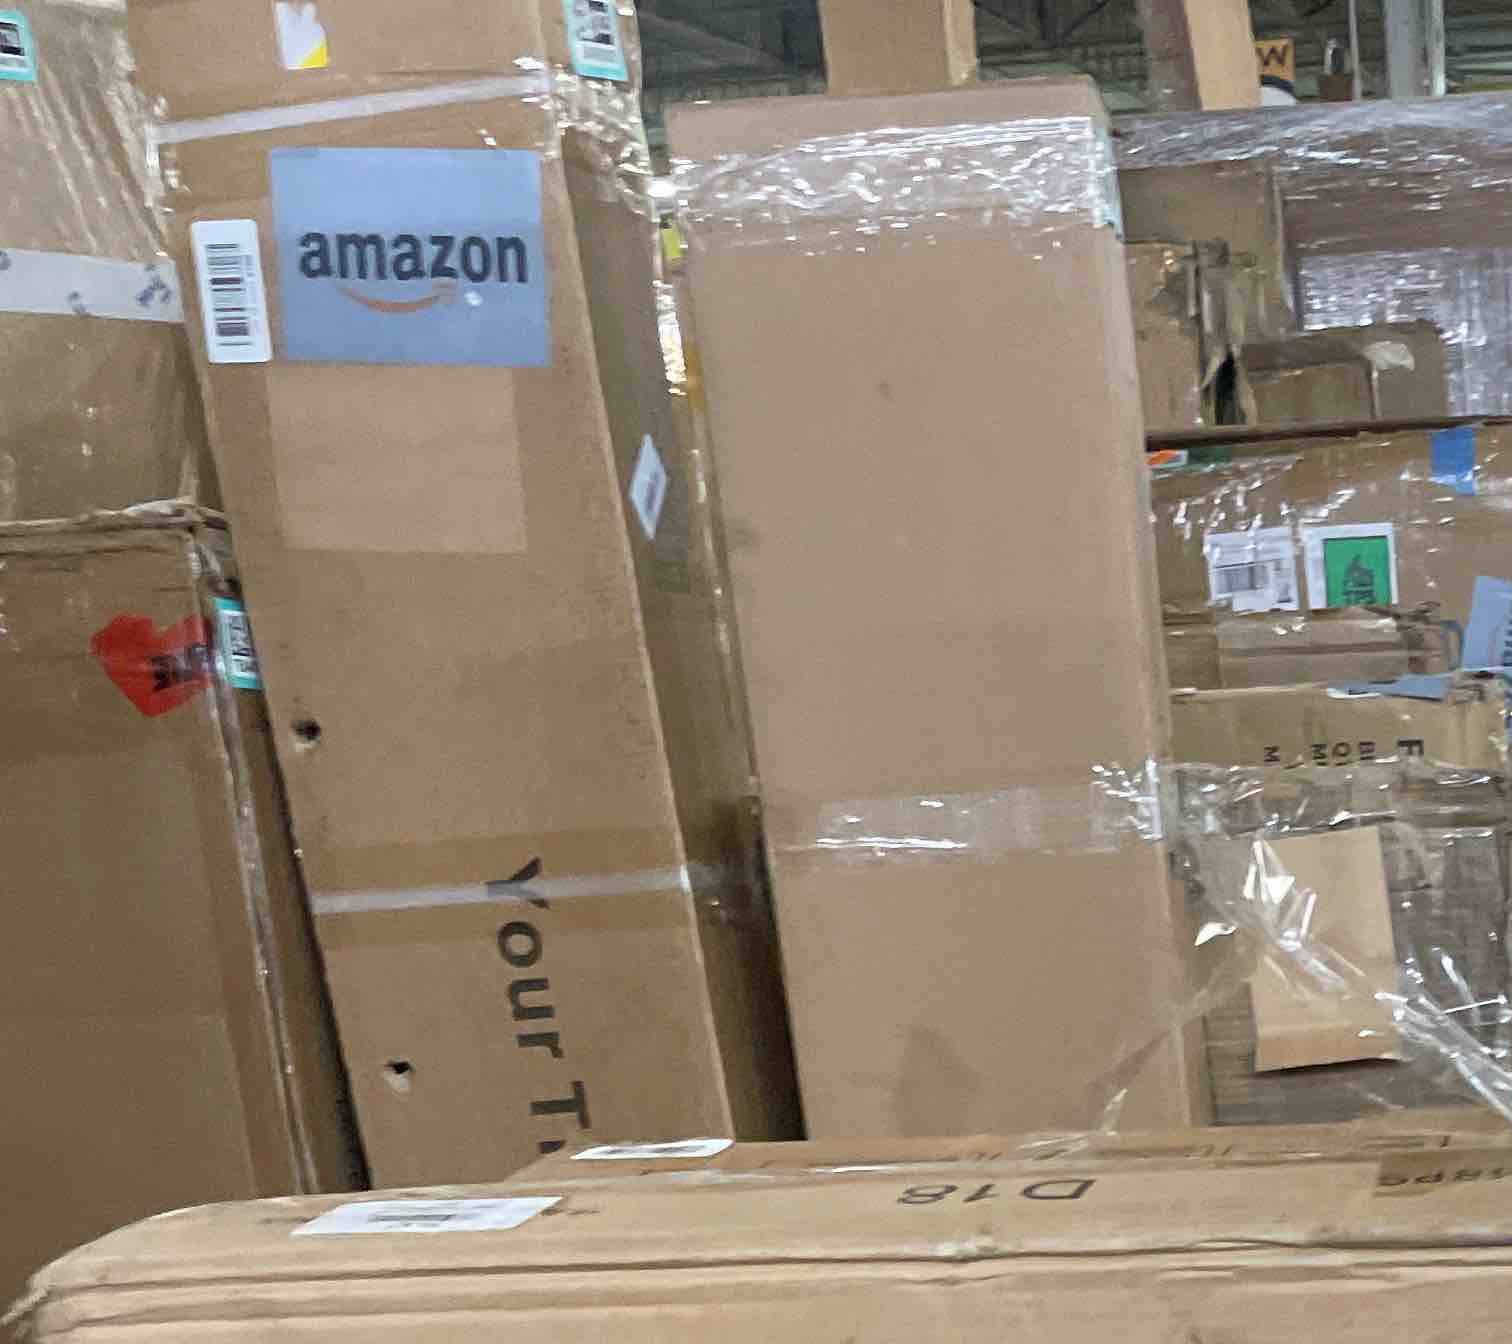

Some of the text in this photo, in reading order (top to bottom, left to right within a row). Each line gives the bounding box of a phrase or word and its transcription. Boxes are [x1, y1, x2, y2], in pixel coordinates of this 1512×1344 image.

[300, 230, 529, 283] amazon
[485, 856, 591, 1154] Your T
